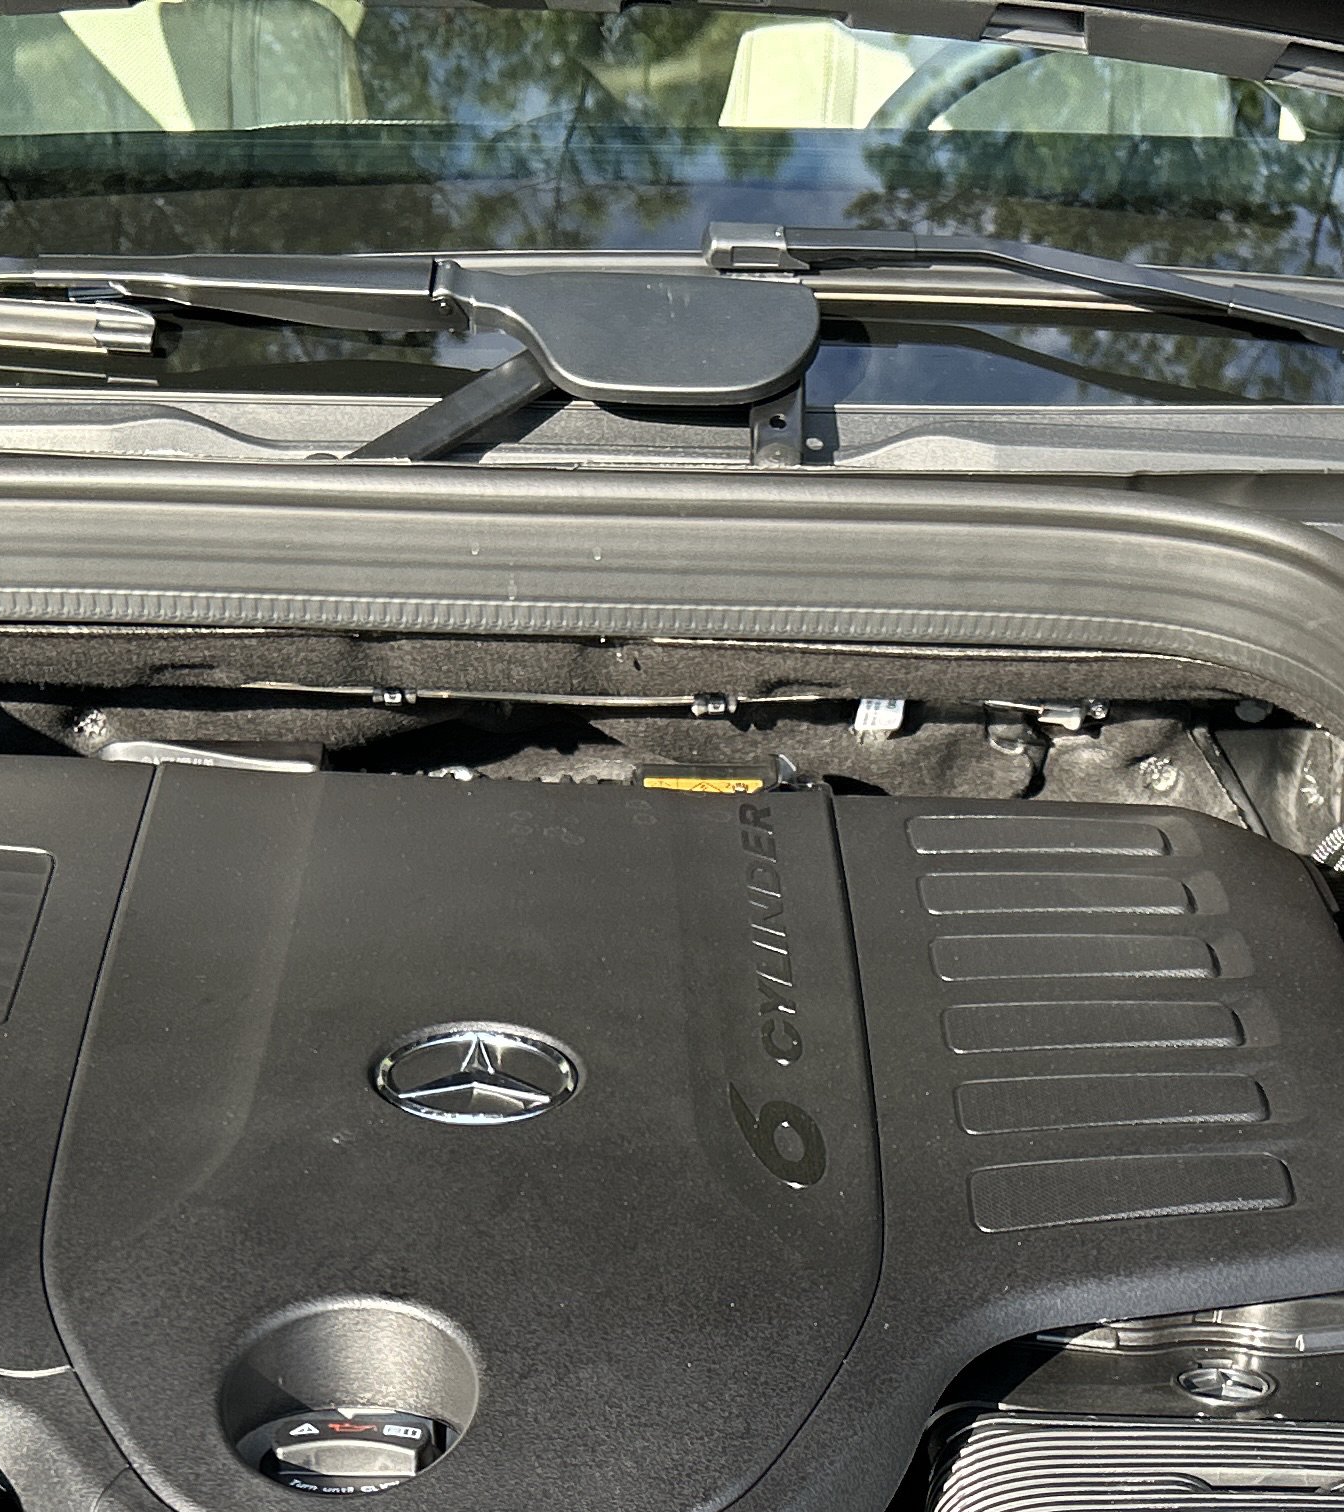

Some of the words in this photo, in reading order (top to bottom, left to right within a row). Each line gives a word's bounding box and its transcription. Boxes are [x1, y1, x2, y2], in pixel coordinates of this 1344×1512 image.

[739, 801, 803, 1067] CYLINDER
[729, 1081, 826, 1190] 6
[289, 1478, 318, 1492] Turn
